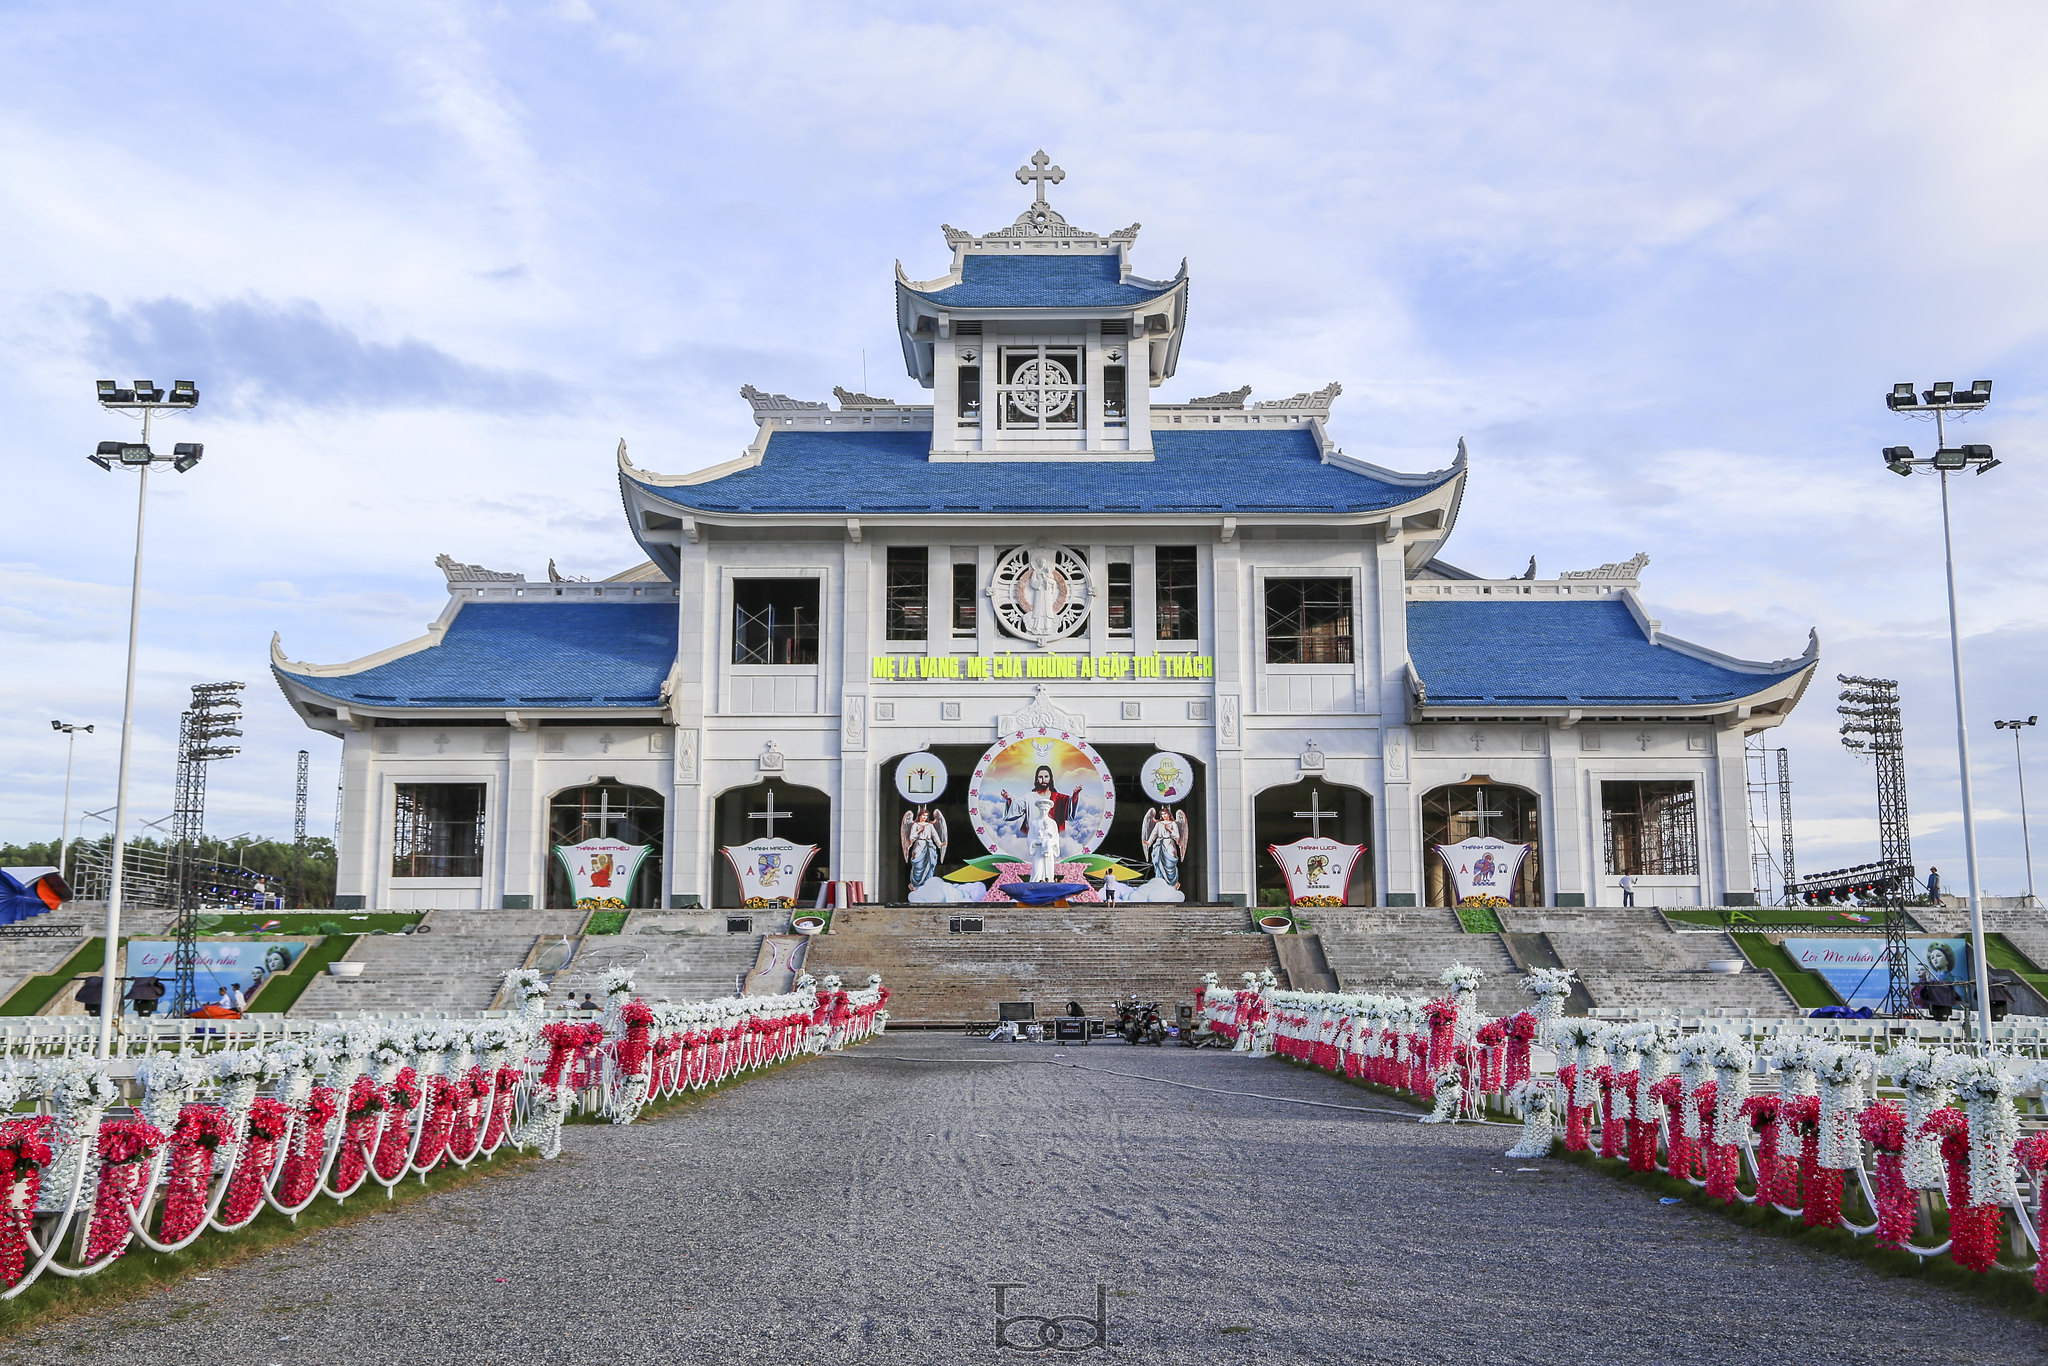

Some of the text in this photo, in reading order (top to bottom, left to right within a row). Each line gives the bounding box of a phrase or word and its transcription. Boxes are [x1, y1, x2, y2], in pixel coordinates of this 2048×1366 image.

[873, 657, 896, 681] MẸ
[899, 657, 917, 678] LA
[967, 657, 990, 681] MẸ
[993, 650, 1023, 678] CỦA
[1080, 656, 1096, 678] AI
[1099, 652, 1130, 681] GẶP
[1132, 650, 1161, 678] THỬ
[1164, 651, 1213, 678] THÁCH
